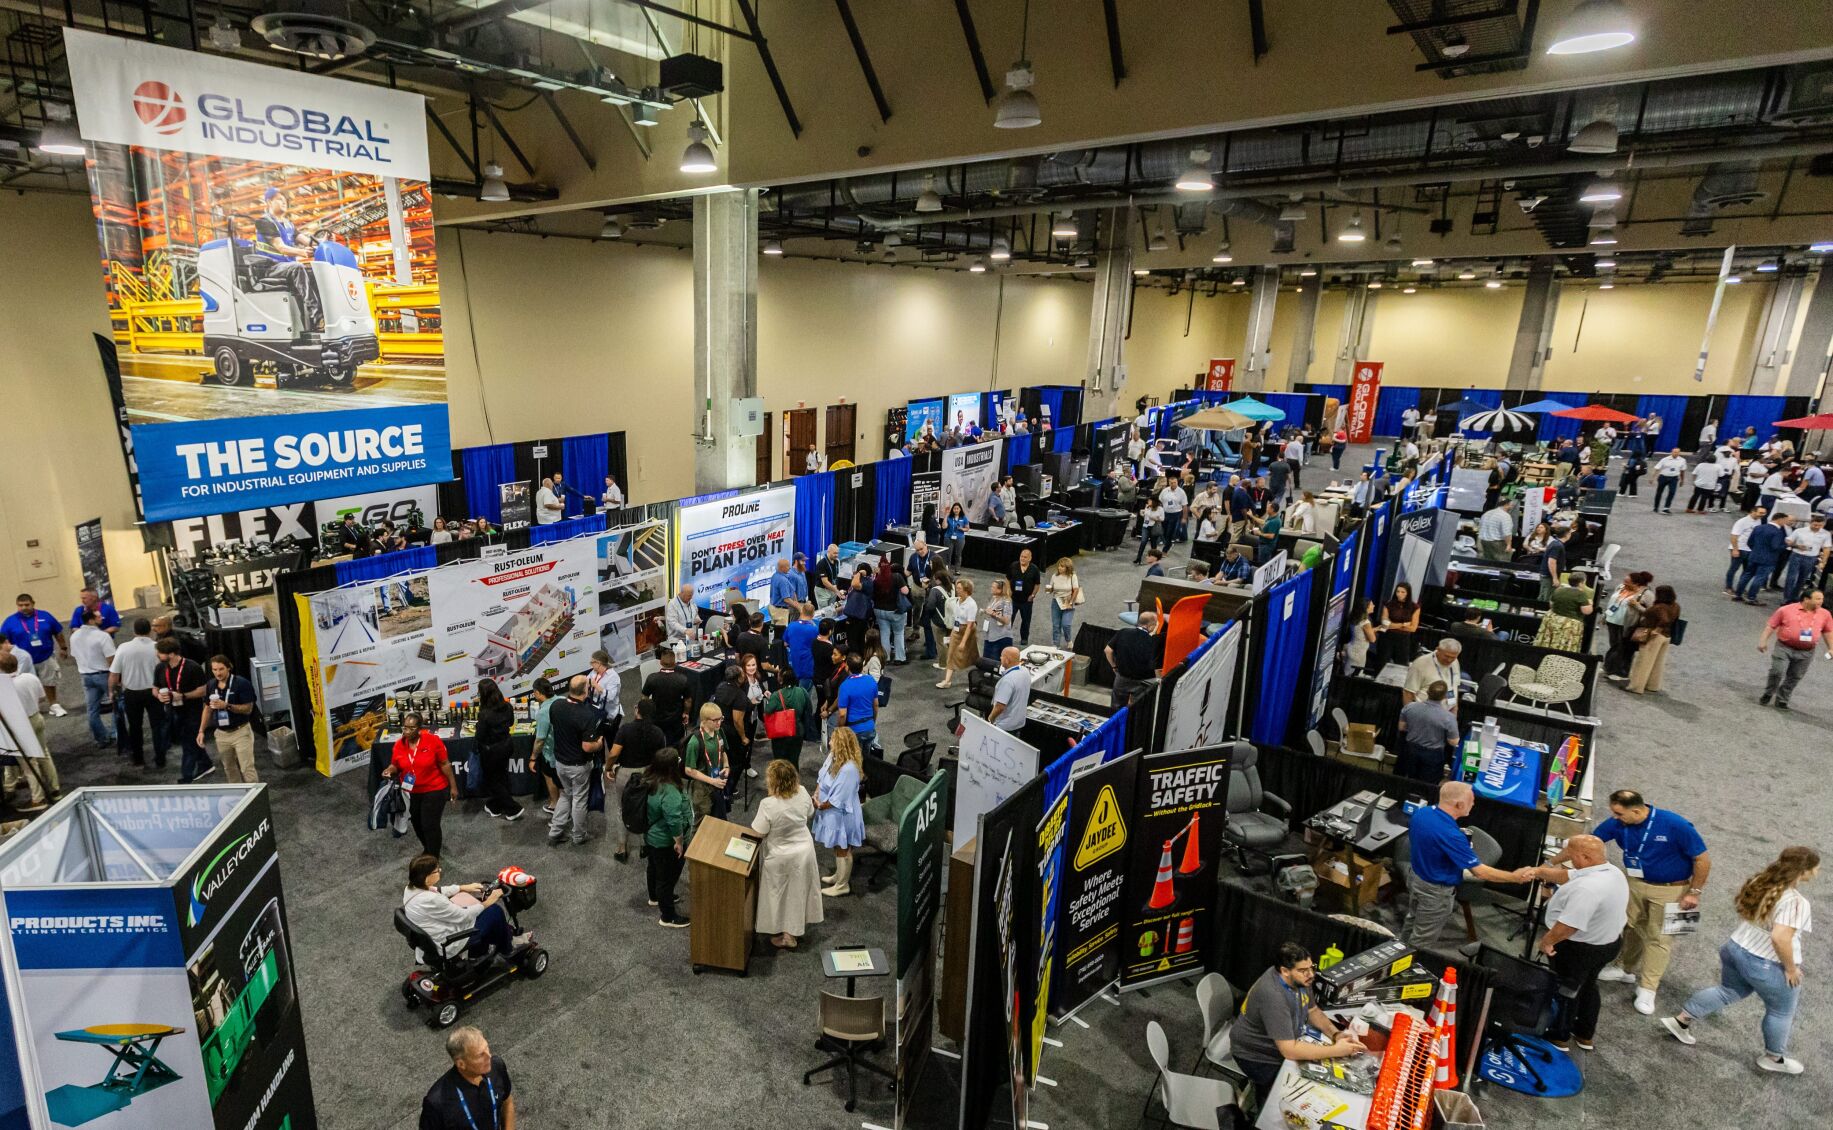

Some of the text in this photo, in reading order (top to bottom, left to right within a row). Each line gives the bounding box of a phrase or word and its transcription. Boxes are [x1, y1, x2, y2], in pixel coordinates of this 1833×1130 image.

[197, 93, 390, 144] GLOBAL
[201, 120, 391, 163] INDUSTRIAL
[1350, 384, 1362, 442] INDUSTRIAL
[1355, 384, 1370, 438] GLOBAL
[176, 423, 424, 480] THE SOURCE
[181, 458, 426, 498] FOR INDUSTRIAL EQUIPMENT AND SUPPLIES
[172, 503, 312, 557] FLEX
[503, 520, 523, 531] FLEX
[691, 529, 785, 560] DON'T STRESS OVER HEAT
[691, 538, 784, 576] PLAN FOR IT
[224, 567, 280, 594] FLEX
[488, 565, 551, 585] PROFESSIONAL SOLUTIONS
[494, 554, 544, 573] RUST-OLEUM
[979, 735, 1016, 770] AIS
[1483, 745, 1513, 789] ARLINGTON
[1150, 764, 1223, 791] TRAFFIC
[1150, 782, 1218, 809] SAFETY
[914, 791, 937, 843] AIS
[1153, 807, 1177, 817] Without
[1188, 801, 1212, 810] Gridlock
[1086, 822, 1117, 850] JAYDEE
[1068, 875, 1124, 914] Safety Meets
[1084, 869, 1112, 892] Where
[10, 915, 167, 929] PRODUCTS INC.
[1071, 886, 1120, 925] Exceptional
[1079, 907, 1110, 932] Service
[260, 1048, 294, 1113] HANDLING
